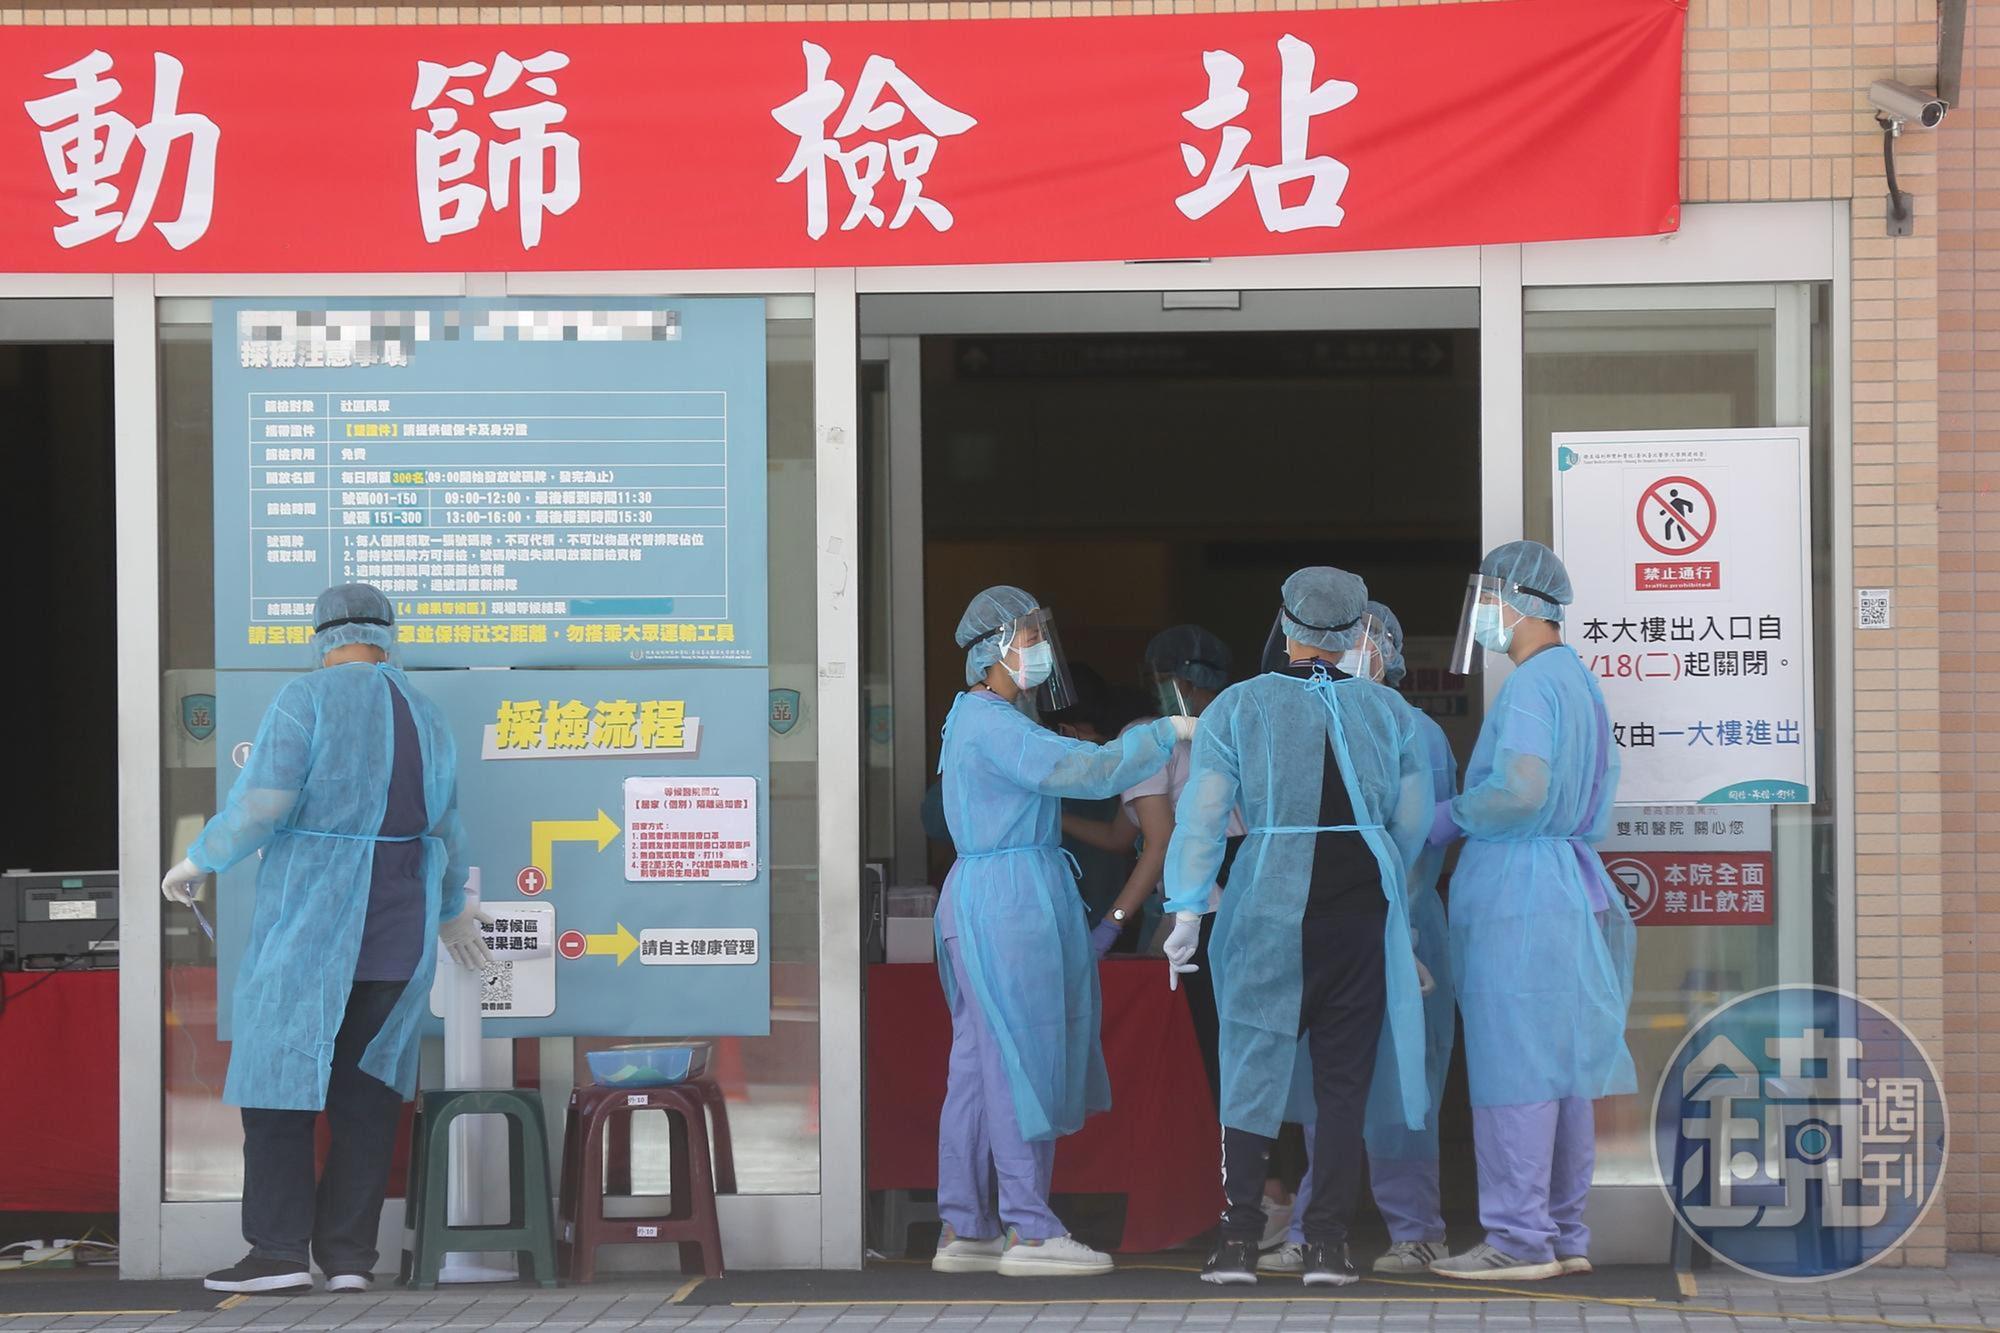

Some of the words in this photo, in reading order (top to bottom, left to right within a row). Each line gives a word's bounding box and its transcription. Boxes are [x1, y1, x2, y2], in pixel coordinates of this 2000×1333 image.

[341, 447, 366, 461] 免費
[1643, 566, 1712, 581] 禁止通行
[1582, 613, 1782, 644] 本大樓出入口自
[1579, 650, 1789, 682] /18(二)起關閉。
[495, 698, 685, 750] 採檢流程
[1617, 820, 1685, 837] 雙和醫院
[1694, 820, 1744, 836] 關心您
[1664, 863, 1765, 886] 本院全面
[1664, 890, 1766, 914] 禁止飲酒
[641, 938, 755, 957] 請自主健康管理
